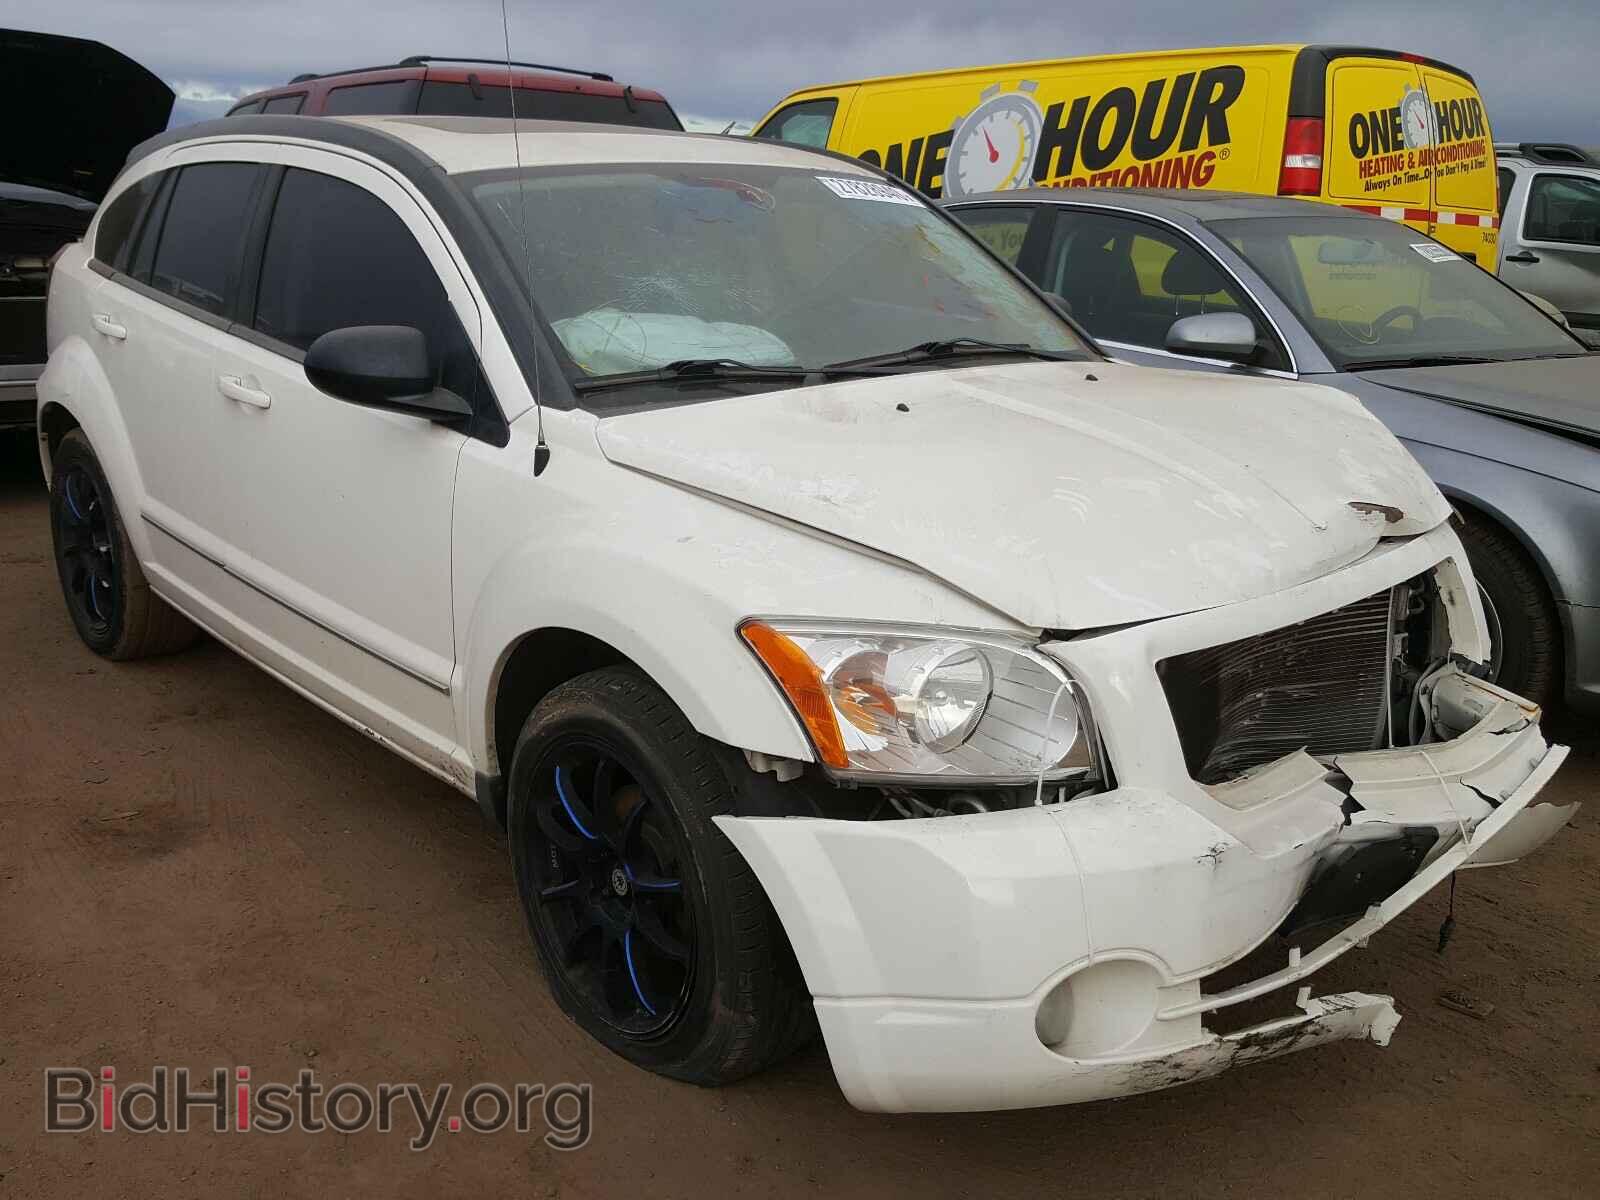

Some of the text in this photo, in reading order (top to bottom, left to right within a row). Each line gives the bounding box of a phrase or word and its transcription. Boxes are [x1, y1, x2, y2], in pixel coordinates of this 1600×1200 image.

[857, 65, 1246, 199] NE HOUR
[1349, 98, 1485, 159] ONE HOUR
[1040, 151, 1217, 188] ITIONING
[1359, 141, 1485, 179] HEATING & AIR CONDITIONING
[1364, 179, 1391, 192] Always
[1392, 175, 1402, 186] On
